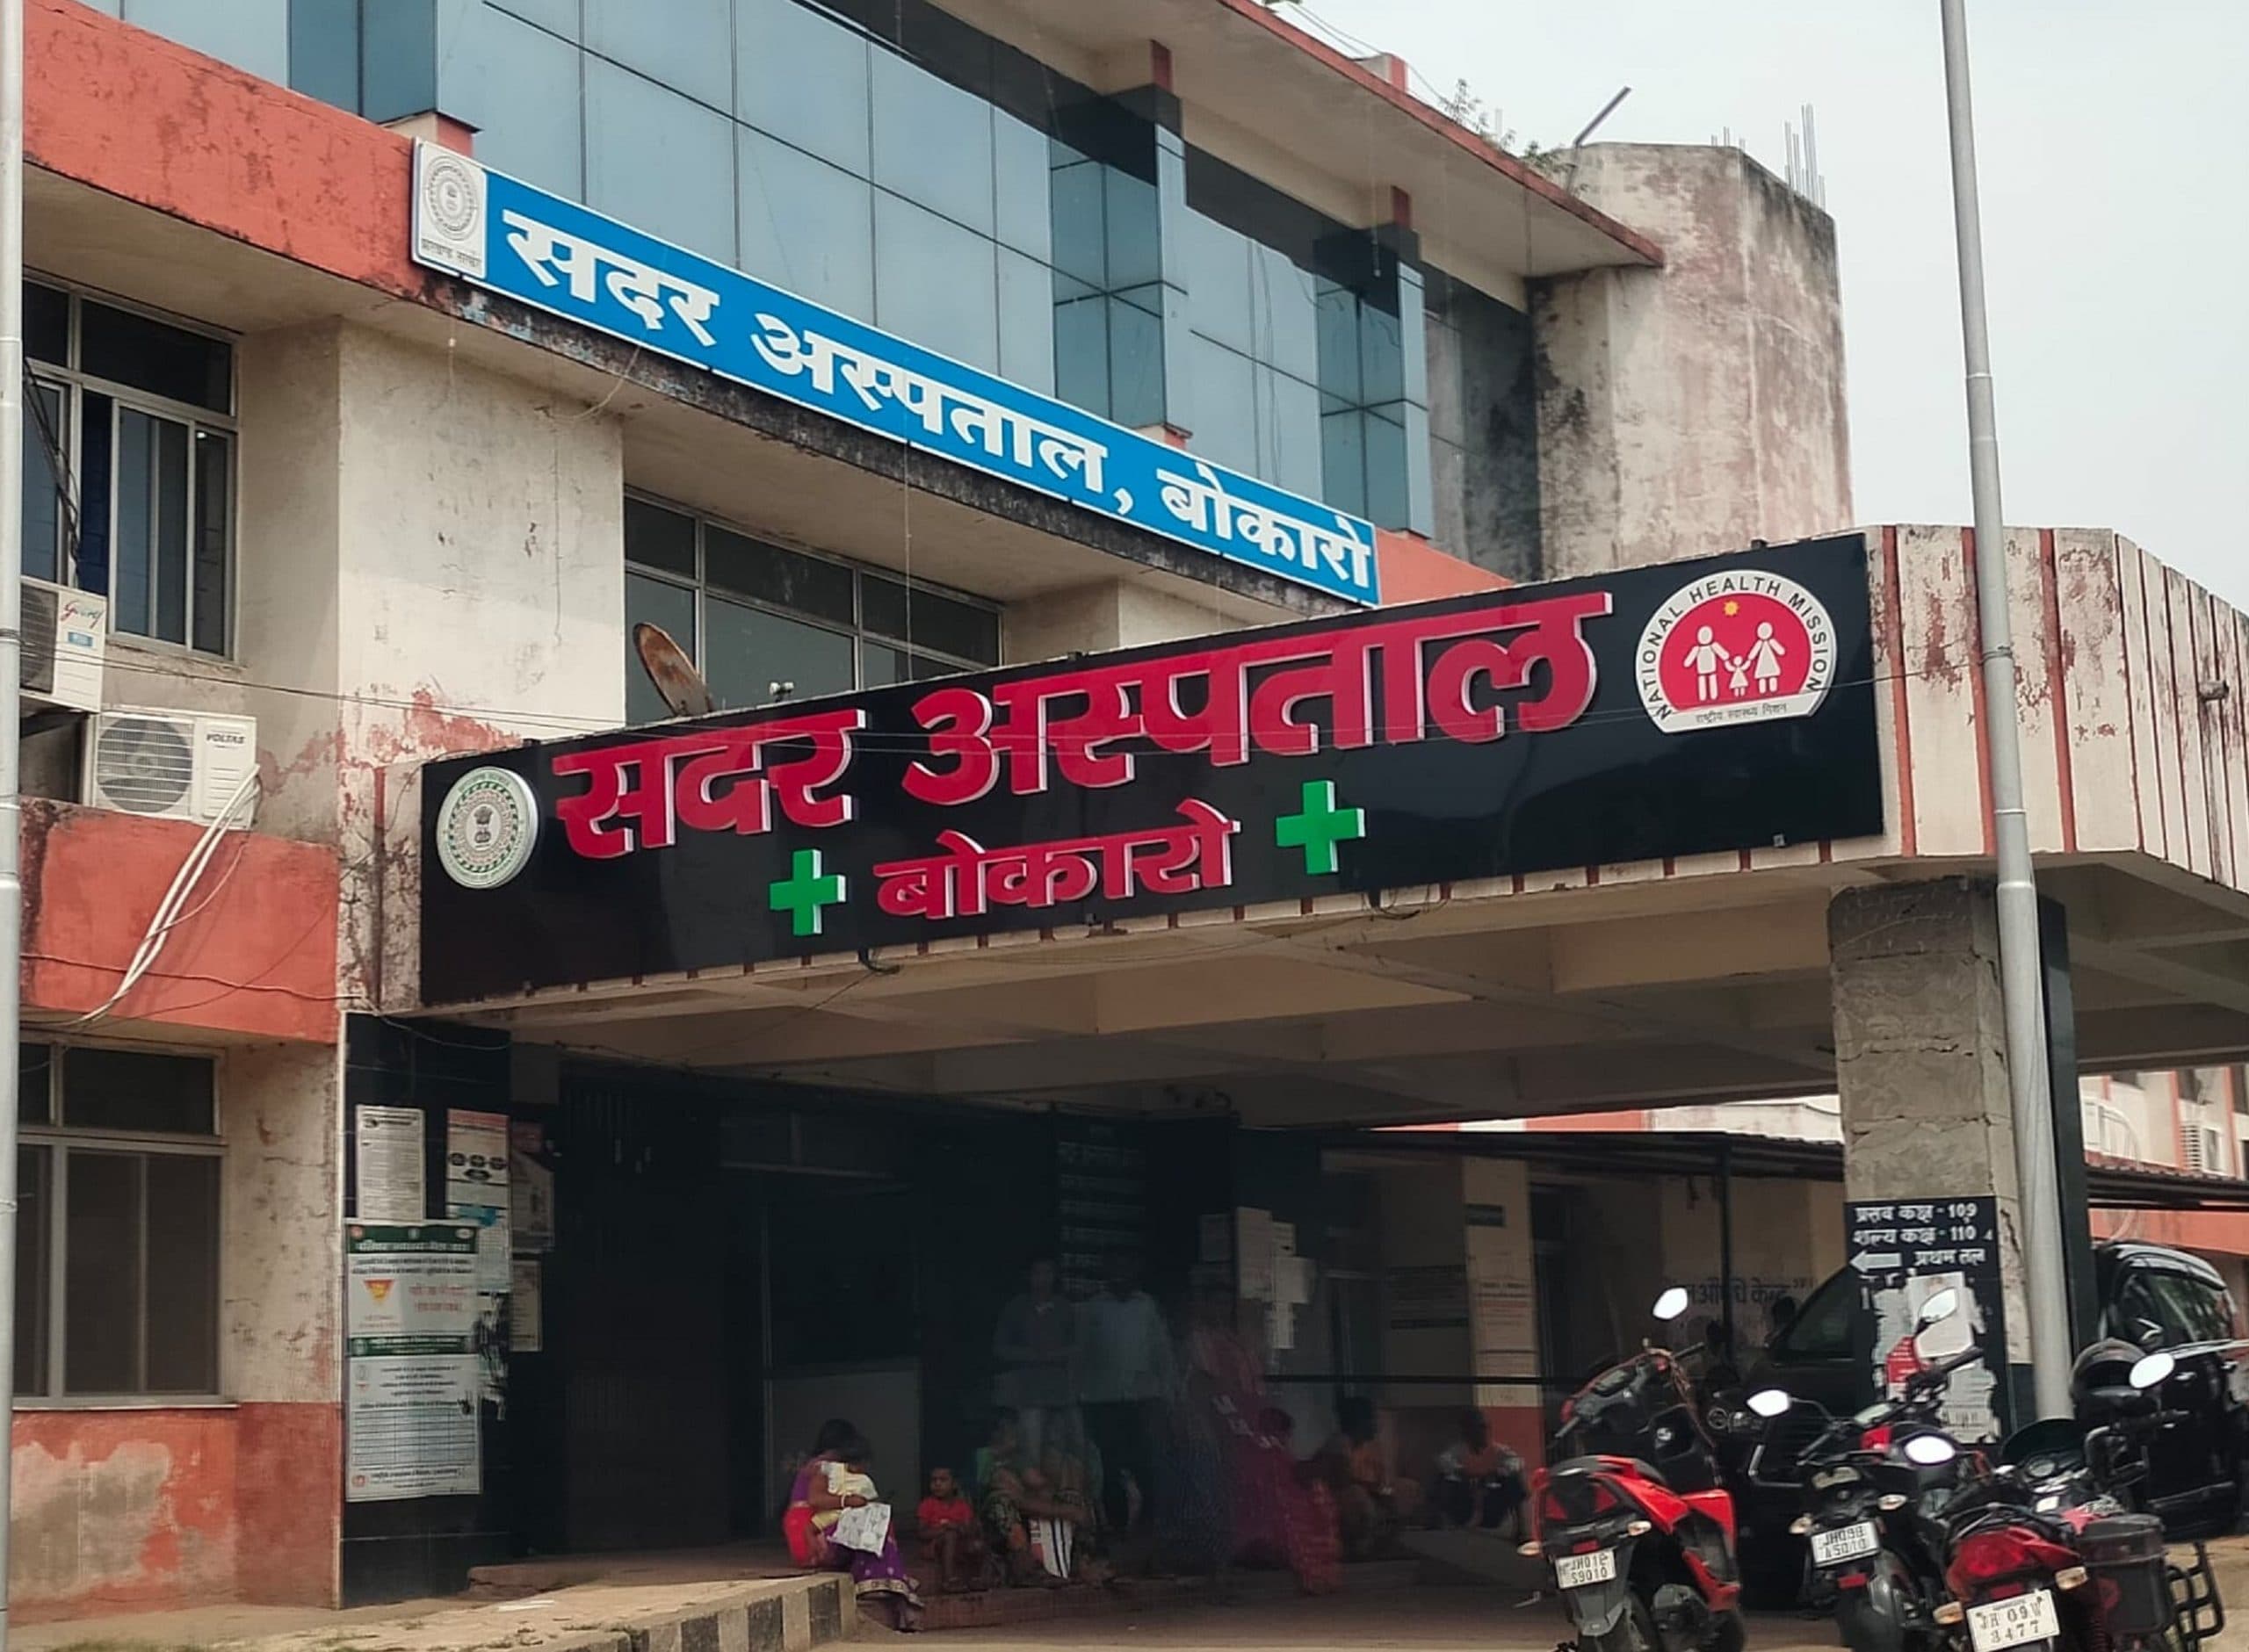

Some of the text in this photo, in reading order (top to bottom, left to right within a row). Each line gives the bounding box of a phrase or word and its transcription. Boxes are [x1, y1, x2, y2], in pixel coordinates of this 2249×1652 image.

[503, 209, 1371, 588] सदर अस्पताल, बोकारो
[1642, 576, 1828, 720] NATIONAL HEALTH MISSION
[206, 733, 246, 744] VOLTAS
[552, 592, 1613, 859] सदर अस्पताल
[872, 797, 1241, 920] बोकारो
[1948, 1203, 1978, 1218] 109
[1950, 1225, 1977, 1241] 110
